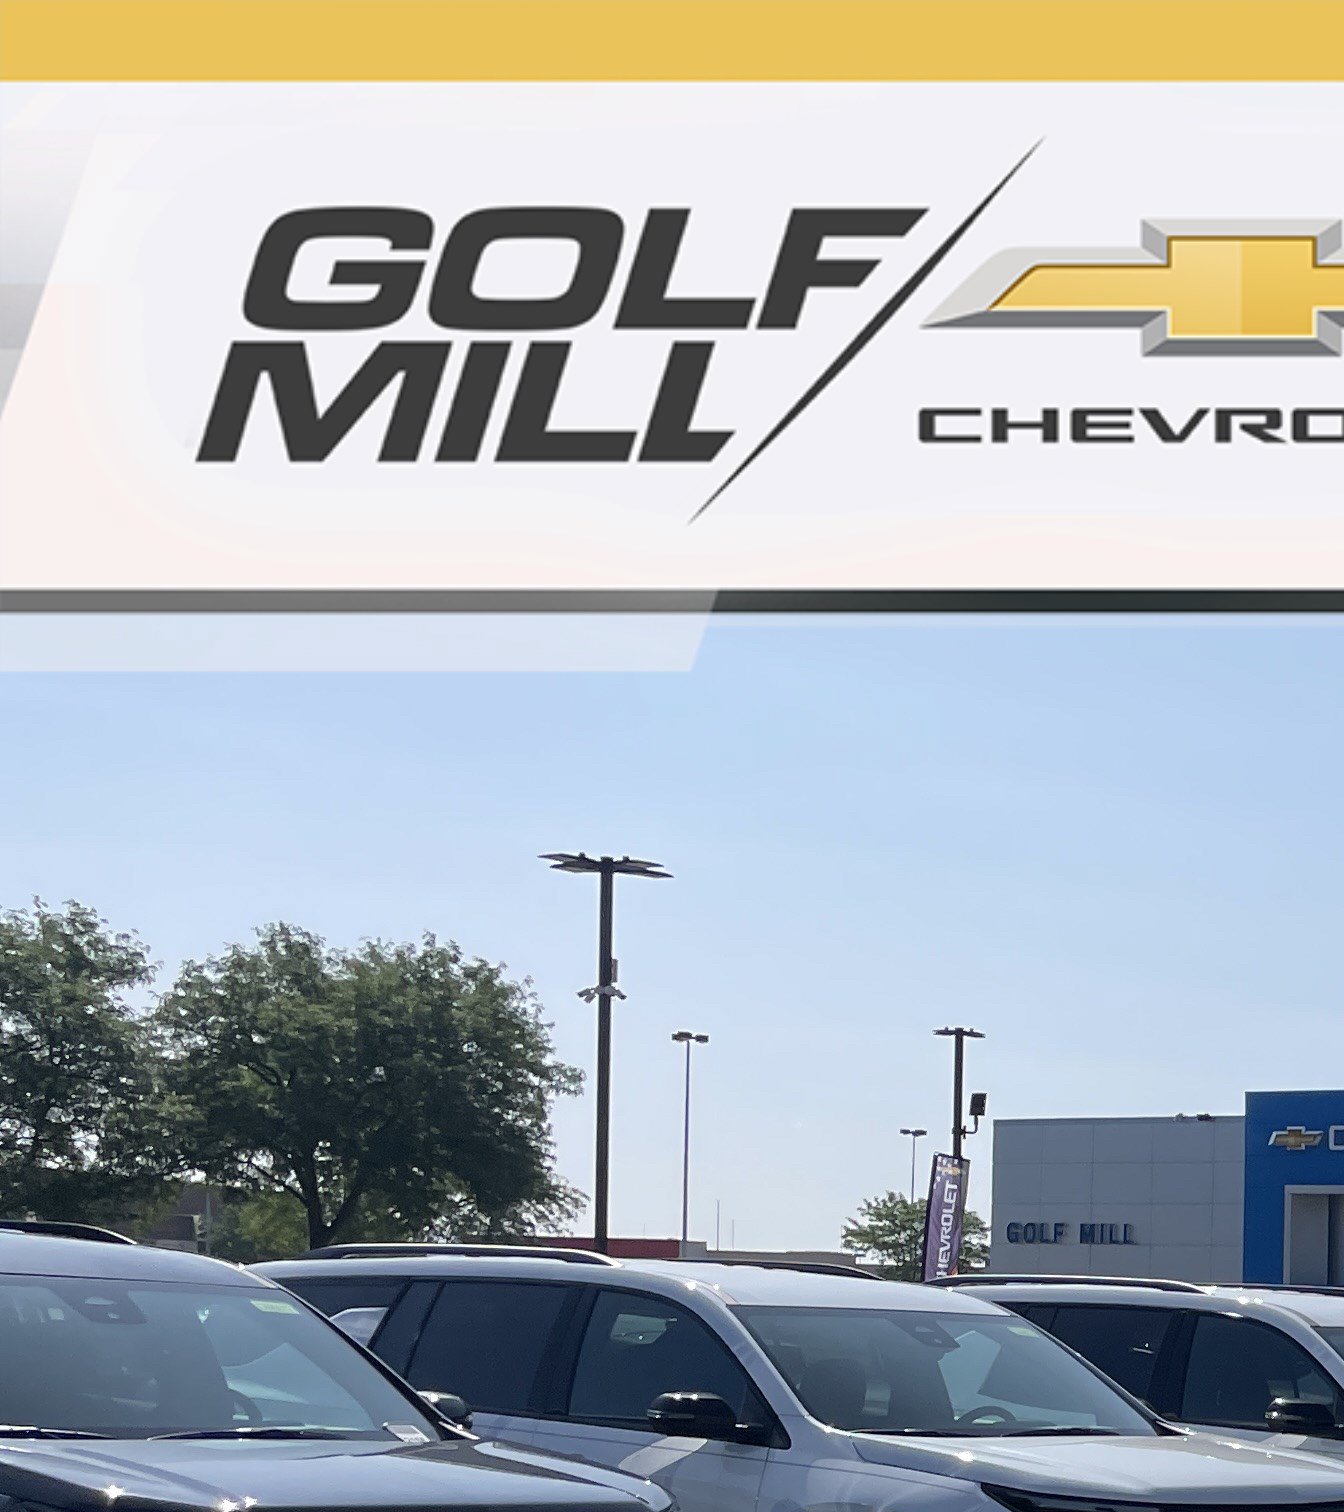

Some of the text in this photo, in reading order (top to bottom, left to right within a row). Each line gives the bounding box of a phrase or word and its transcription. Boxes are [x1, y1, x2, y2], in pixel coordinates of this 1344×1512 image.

[936, 1179, 959, 1278] HEVROLET
[1006, 1221, 1137, 1245] GOLF MILL
